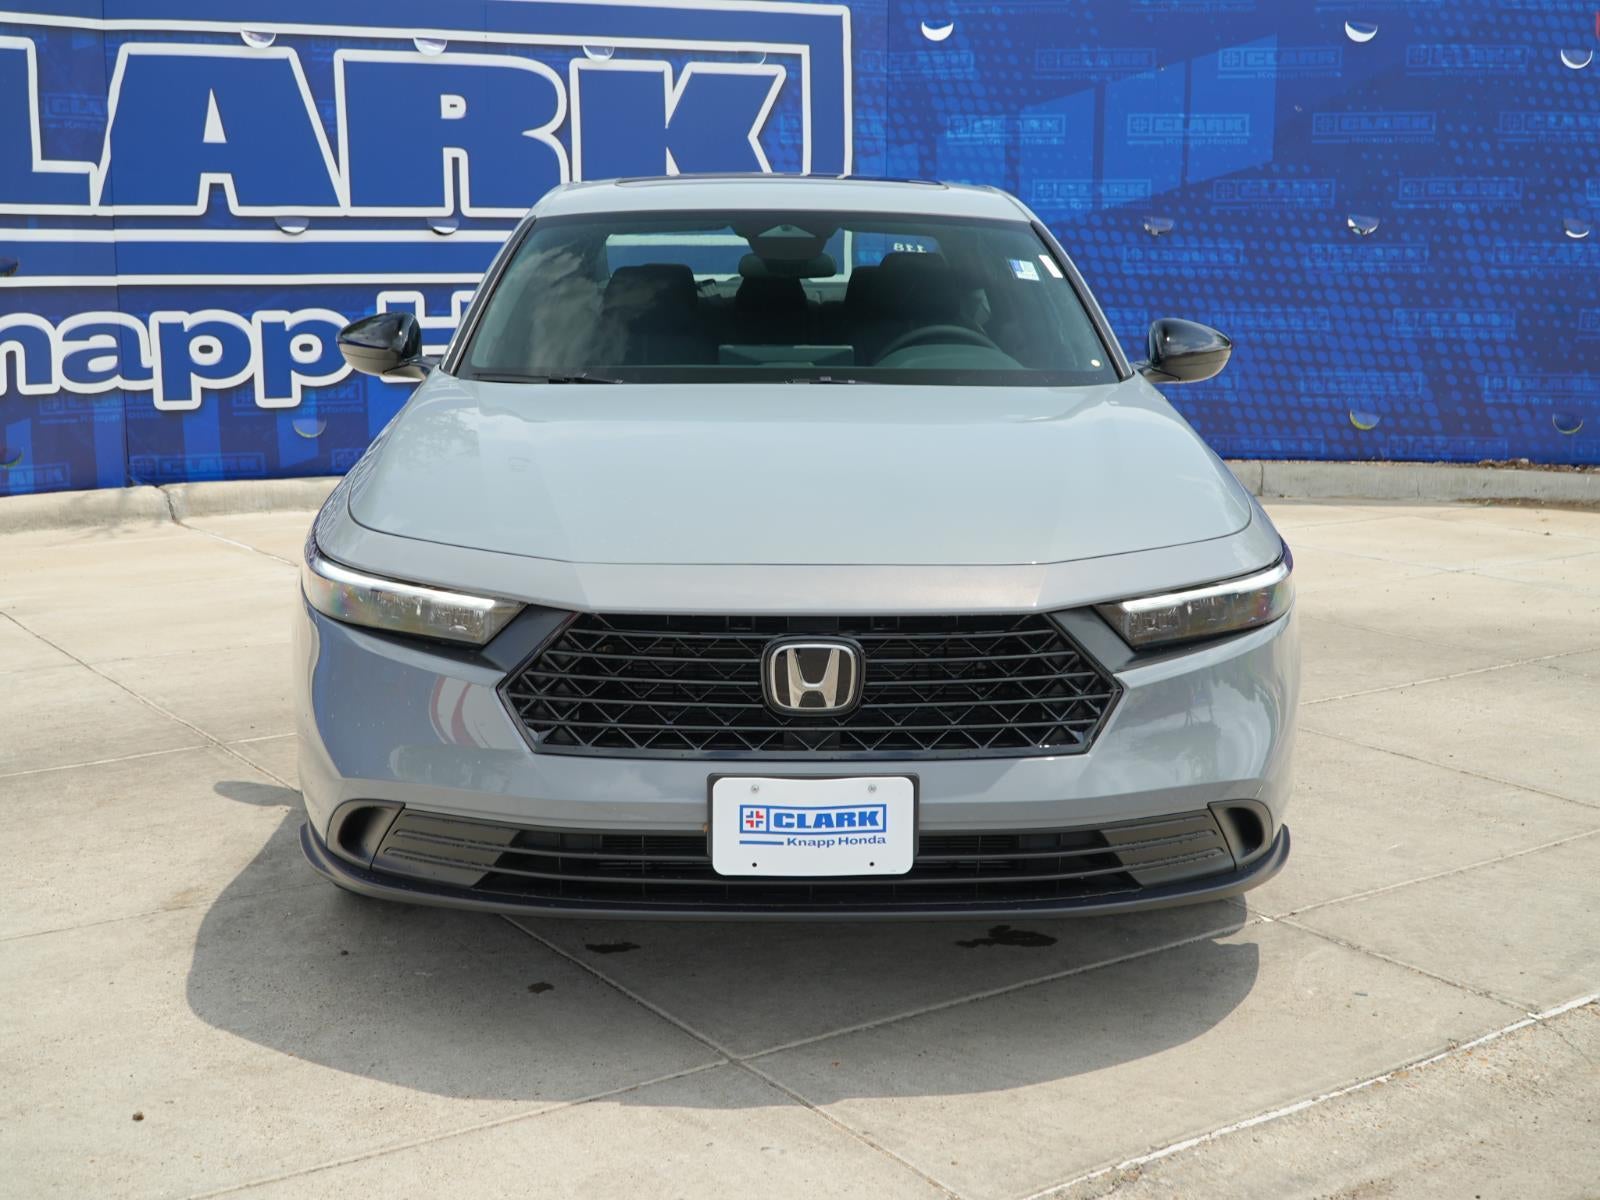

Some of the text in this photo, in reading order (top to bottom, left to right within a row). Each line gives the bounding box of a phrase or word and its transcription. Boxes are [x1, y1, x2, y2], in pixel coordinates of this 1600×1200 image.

[773, 810, 880, 829] CLARK
[786, 834, 887, 849] Knapp Honda
